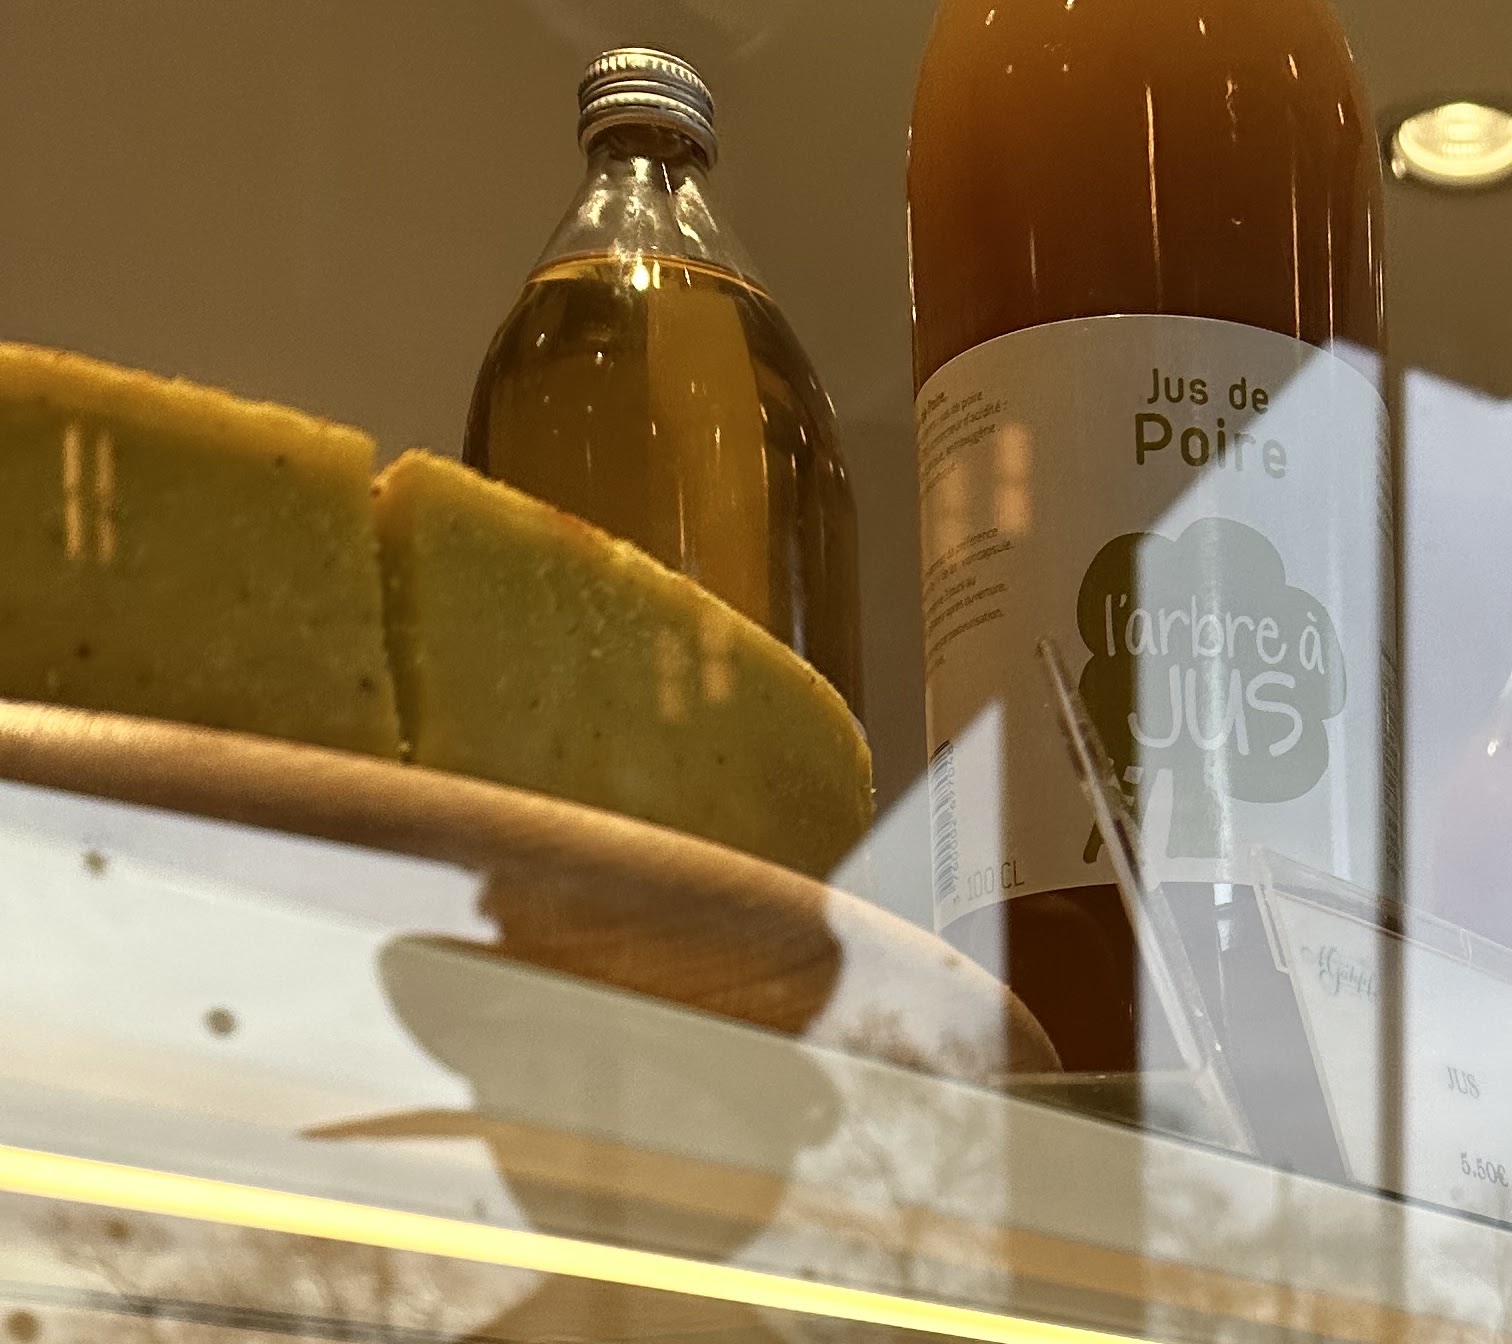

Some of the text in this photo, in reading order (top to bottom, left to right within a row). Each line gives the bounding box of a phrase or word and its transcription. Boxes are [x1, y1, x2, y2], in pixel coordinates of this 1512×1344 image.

[1148, 368, 1269, 414] Jus de
[1134, 412, 1288, 479] Poire
[1105, 594, 1325, 675] l'arbre à
[1128, 664, 1303, 757] JUS
[1001, 860, 1025, 889] CL
[1446, 1064, 1480, 1099] JUS
